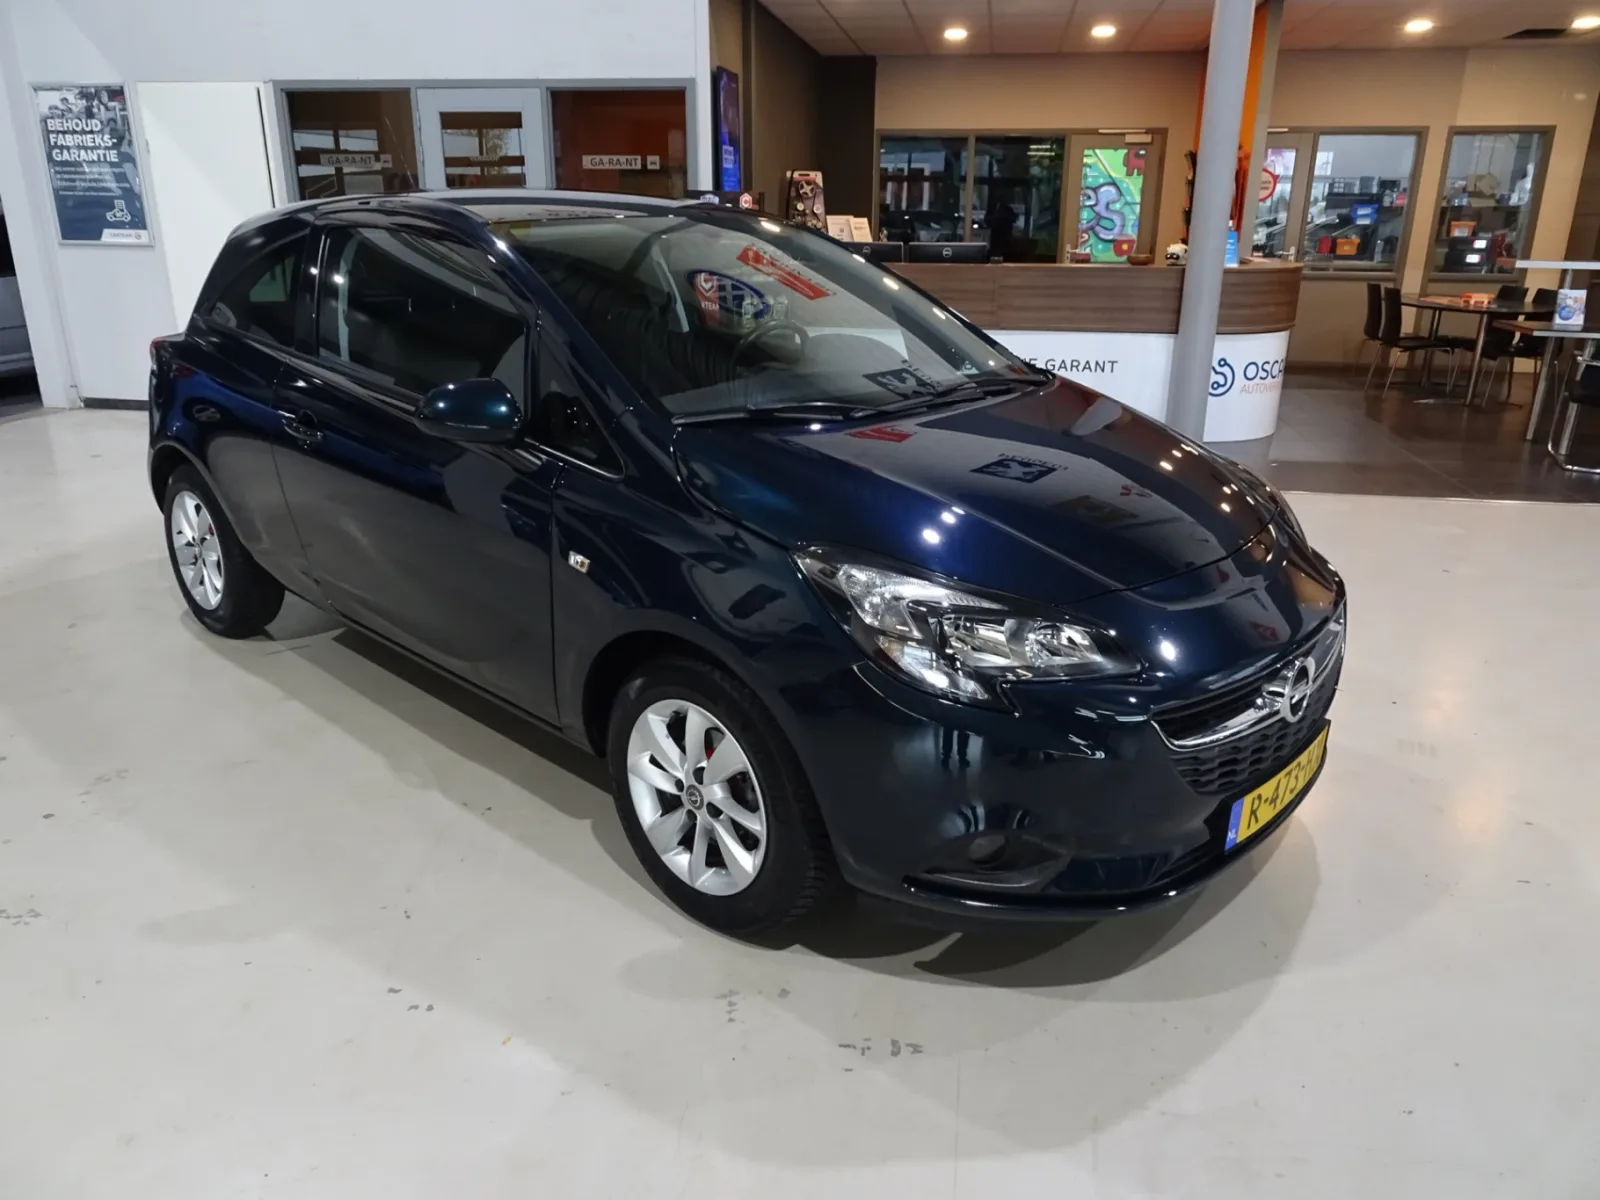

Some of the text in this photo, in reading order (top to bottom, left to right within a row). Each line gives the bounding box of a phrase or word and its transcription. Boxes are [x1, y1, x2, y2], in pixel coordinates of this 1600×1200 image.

[47, 119, 101, 131] BEHOUD
[49, 134, 117, 147] FABRIEKS-
[52, 149, 119, 162] GARANTIE
[590, 157, 639, 167] GA-RA-NT
[1044, 358, 1119, 373] GARANT
